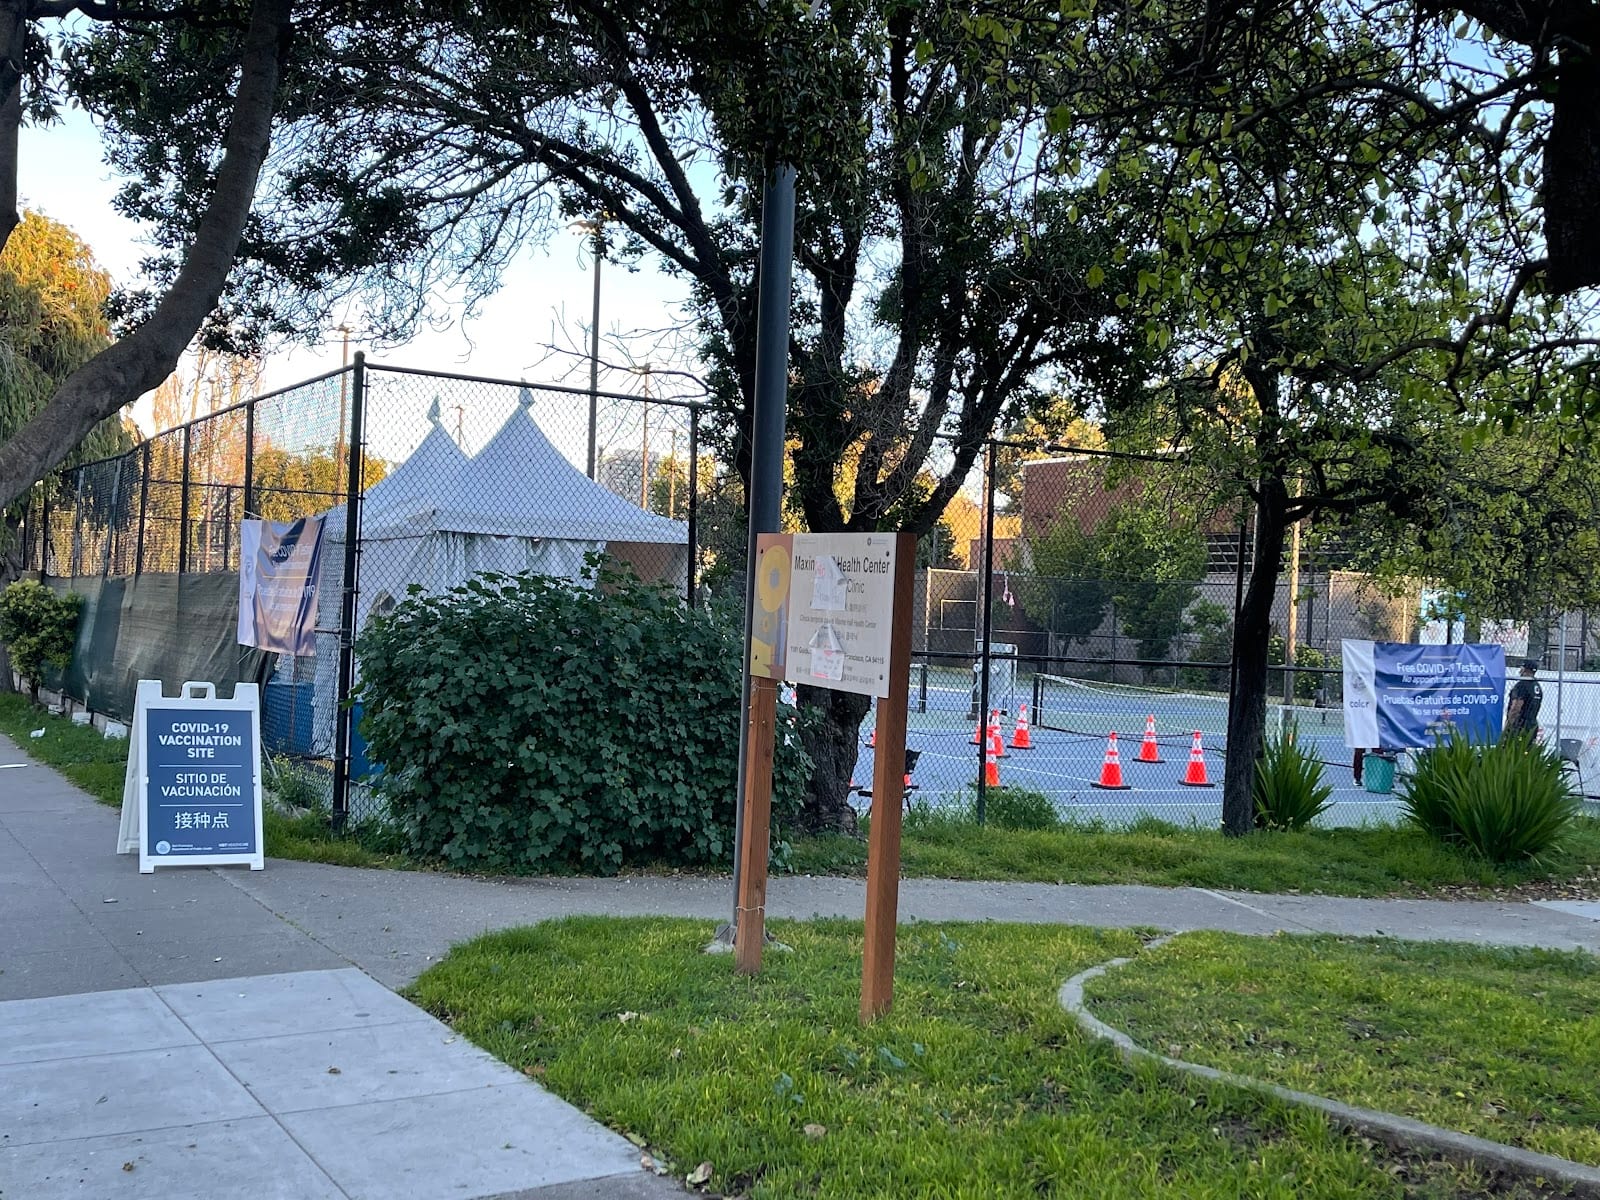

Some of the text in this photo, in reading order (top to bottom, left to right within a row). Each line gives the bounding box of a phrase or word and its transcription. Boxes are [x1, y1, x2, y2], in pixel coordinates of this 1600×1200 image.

[794, 555, 816, 571] Maxin
[836, 556, 861, 573] Health
[862, 557, 890, 575] Center
[847, 578, 865, 594] Clinic
[1396, 662, 1416, 673] Free
[1456, 662, 1486, 675] Testing
[1402, 674, 1481, 685] No appointment required
[1383, 694, 1499, 706] Pruebas Gratuitas de COVID-19
[1412, 707, 1421, 716] No
[1422, 708, 1431, 716] se
[1457, 707, 1470, 716] cita
[171, 722, 229, 734] COVID-19
[158, 735, 241, 746] VACCINATION
[187, 747, 215, 759] SITE
[175, 773, 227, 785] SITIO DE
[161, 784, 241, 797] VACUNACIÓN
[174, 811, 230, 829] 接种点
